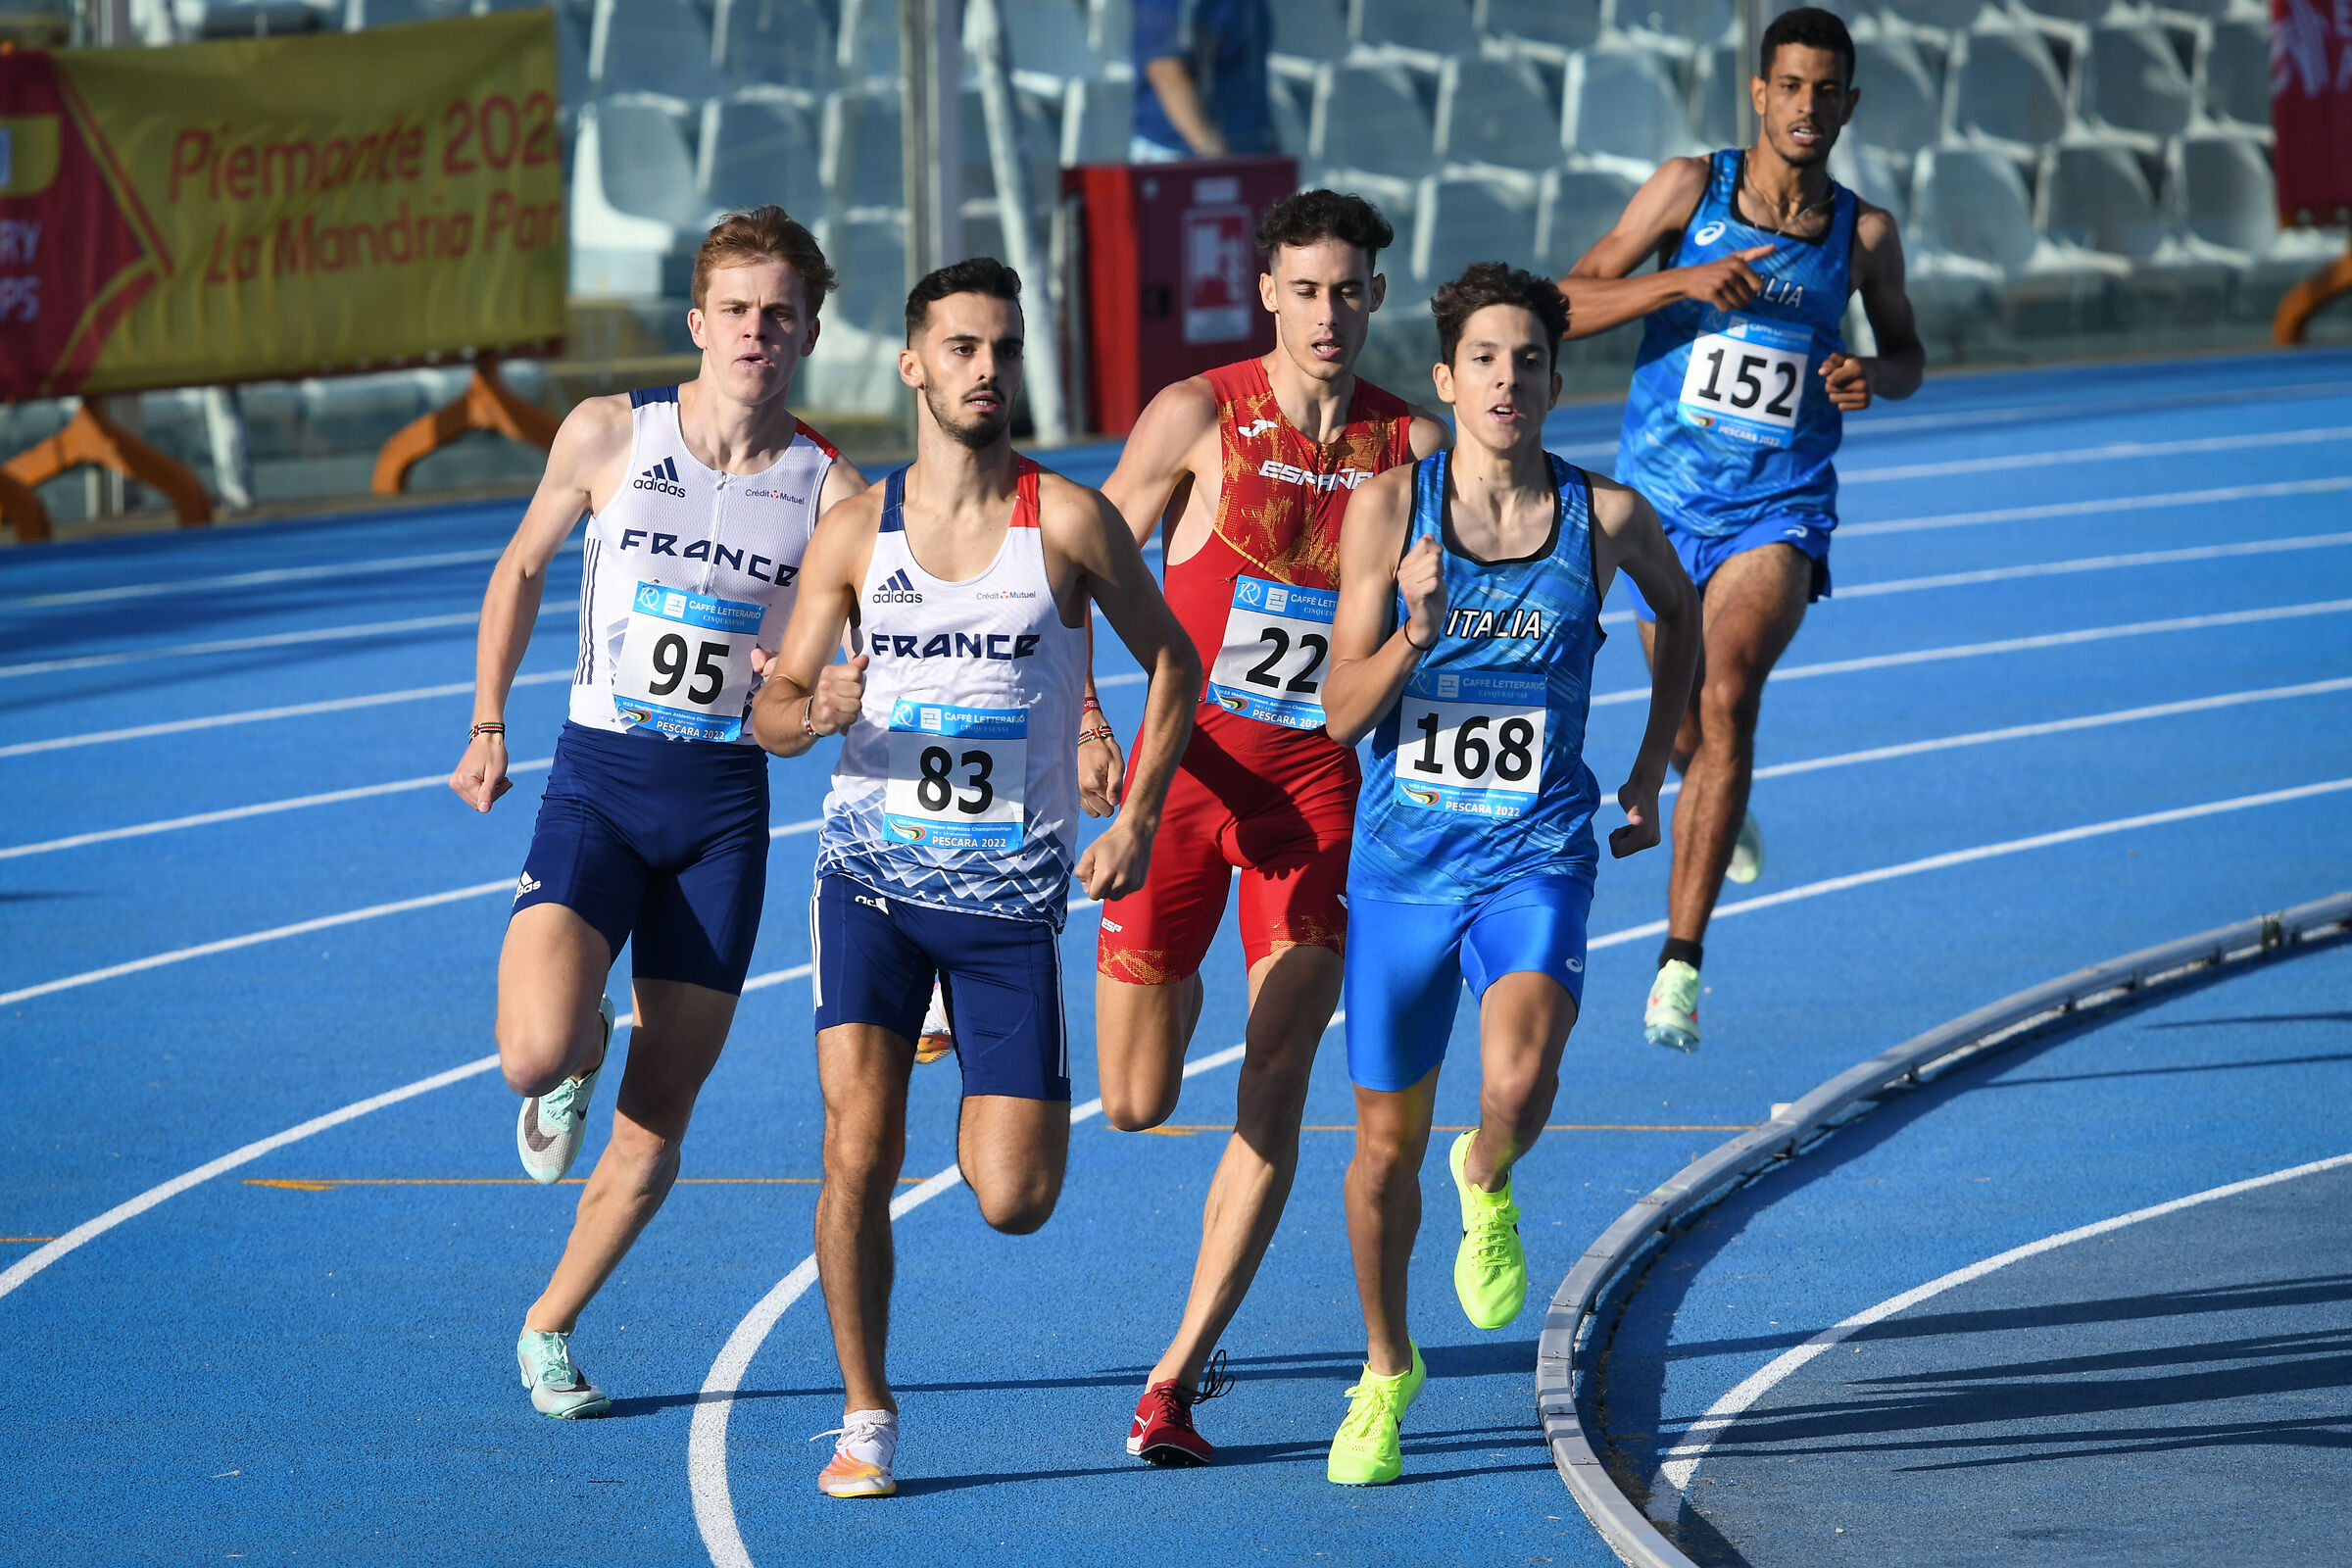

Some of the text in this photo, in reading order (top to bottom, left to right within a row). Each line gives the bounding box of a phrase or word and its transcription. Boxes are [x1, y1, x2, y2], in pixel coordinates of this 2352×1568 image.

[169, 111, 425, 202] Piemonte
[205, 222, 259, 284] La
[275, 198, 472, 275] Mandria
[1697, 348, 1797, 417] 152
[633, 478, 686, 498] adidas
[780, 493, 806, 505] Mutuel
[619, 528, 800, 588] FRANCE
[872, 590, 923, 604] adidas
[1009, 591, 1037, 600] Mutuel
[717, 606, 761, 619] LETTERARIO
[1446, 609, 1542, 640] ITALIA
[871, 632, 1041, 661] FRANCE
[648, 633, 731, 705] 95
[1245, 626, 1329, 695] 22
[1493, 678, 1545, 690] LETTERARIO
[974, 713, 1025, 724] LETTERARIO
[1251, 710, 1297, 726] PESCARA
[656, 720, 725, 740] PESCARA 2022
[1413, 712, 1535, 782] 168
[917, 746, 994, 815] 83
[1446, 801, 1521, 817] PESCARA 2022
[932, 836, 1006, 848] PESCARA 2022
[1102, 916, 1123, 933] ESP
